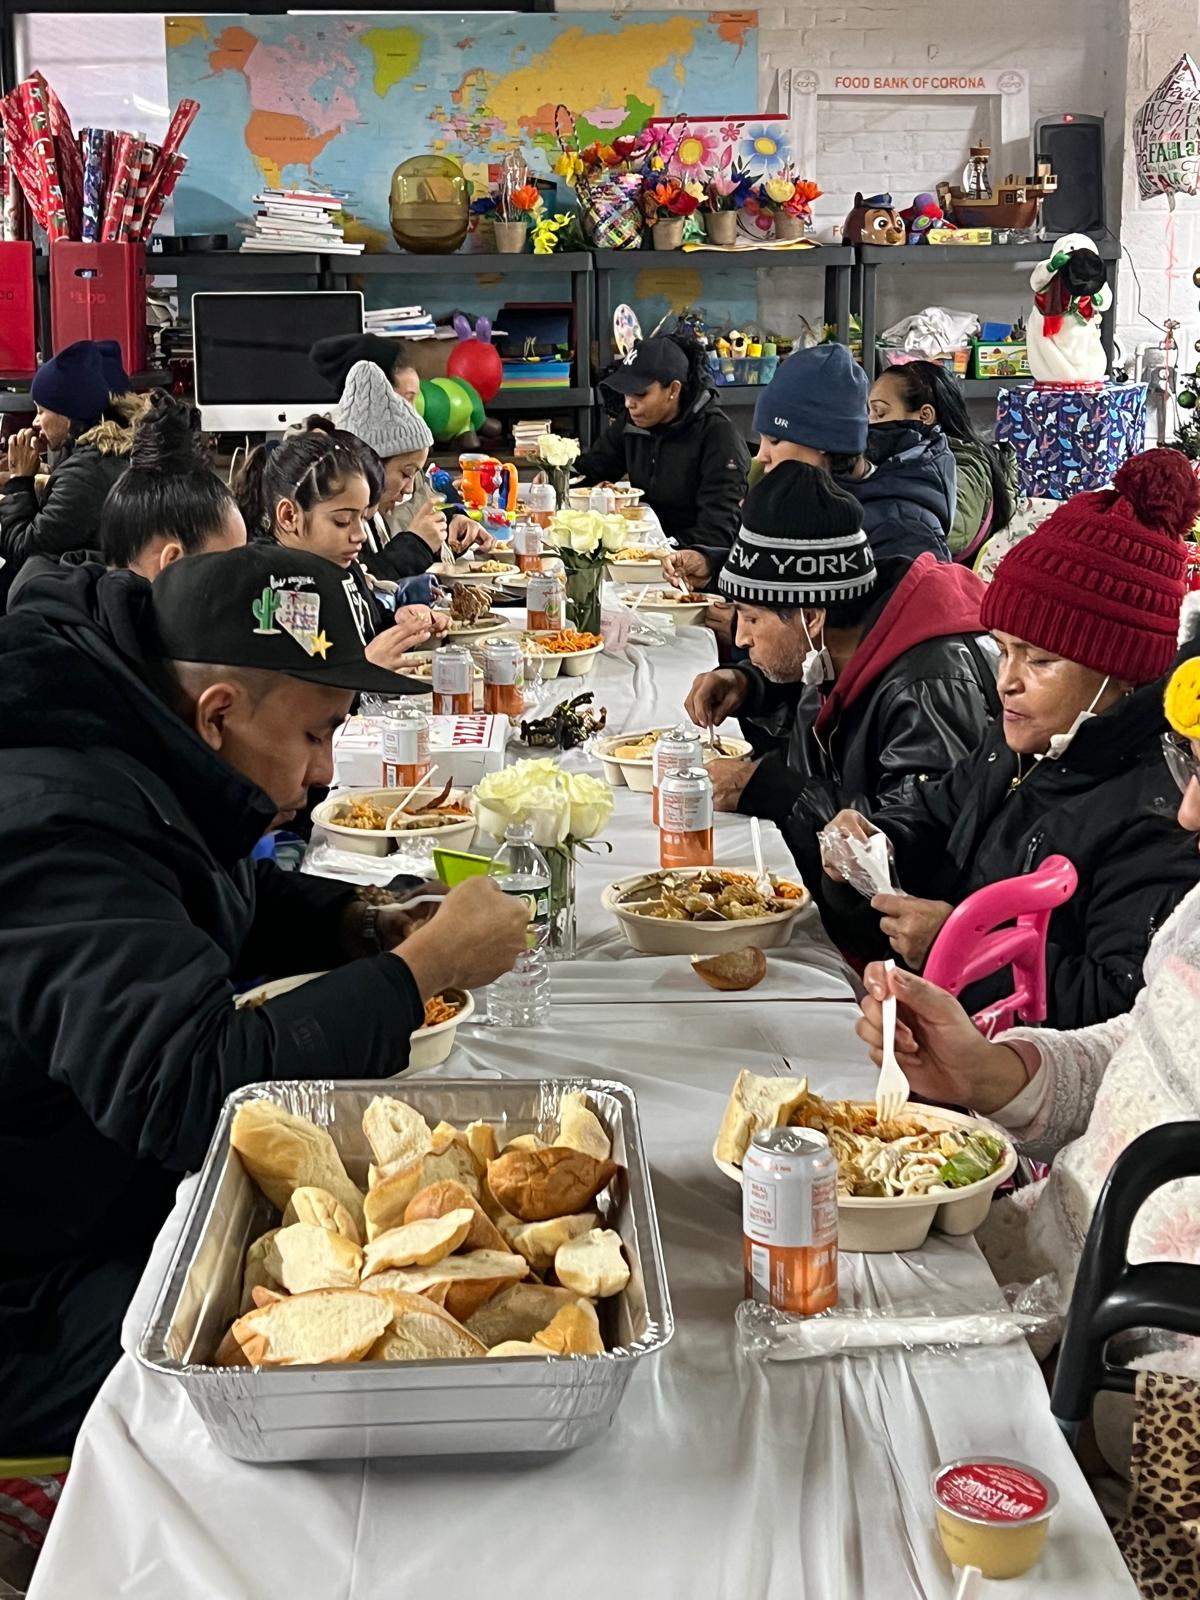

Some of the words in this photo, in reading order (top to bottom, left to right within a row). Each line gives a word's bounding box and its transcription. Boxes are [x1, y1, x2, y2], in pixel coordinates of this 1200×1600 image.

[835, 77, 870, 88] FOOD
[873, 77, 909, 88] BANK
[912, 77, 930, 88] OF
[931, 77, 985, 88] CORONA
[1148, 142, 1168, 163] FA
[728, 543, 760, 570] EW
[770, 552, 859, 575] YORK
[452, 715, 488, 746] PIZZA
